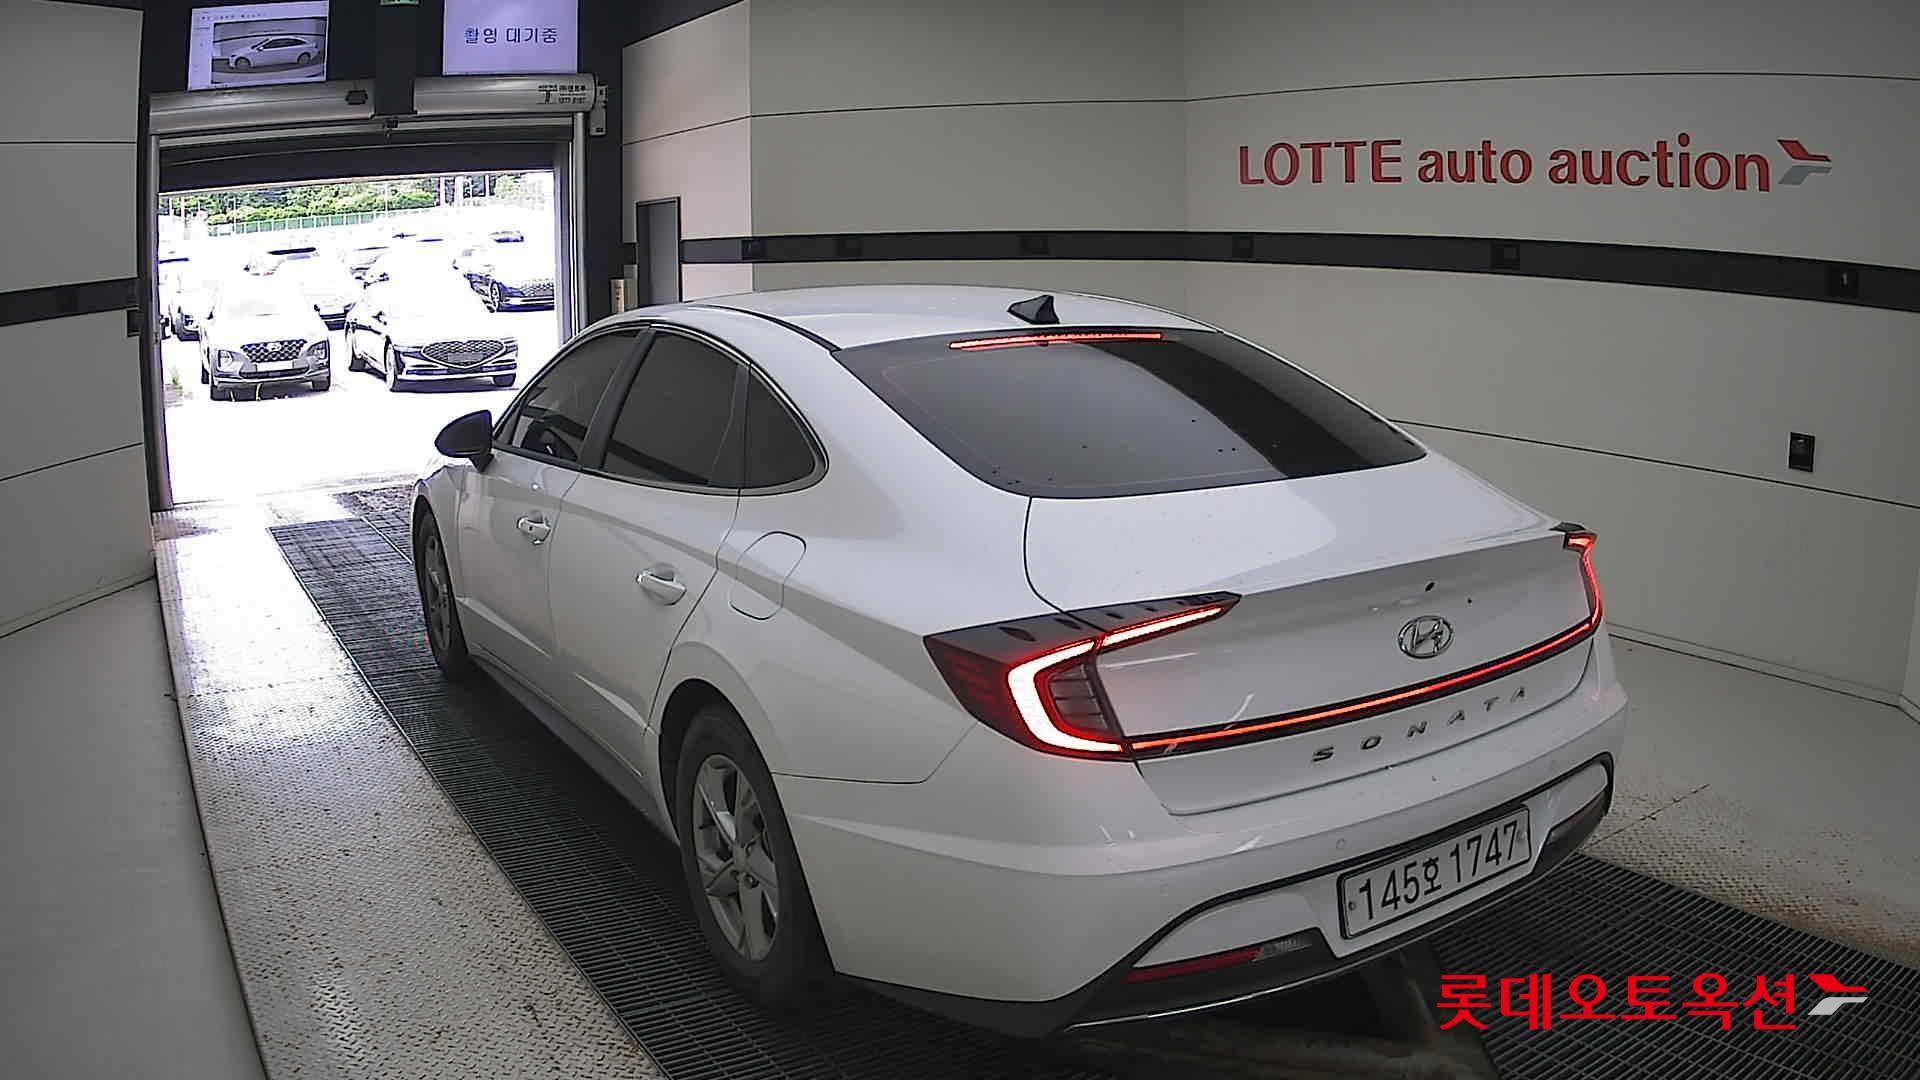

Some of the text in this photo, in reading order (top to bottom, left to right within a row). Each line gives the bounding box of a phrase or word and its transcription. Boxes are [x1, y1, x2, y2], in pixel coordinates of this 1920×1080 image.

[506, 27, 558, 44] 대기중
[1239, 133, 1771, 193] LOTTE auto auction
[1311, 686, 1526, 763] SONATA
[1358, 819, 1520, 921] 145호 1747
